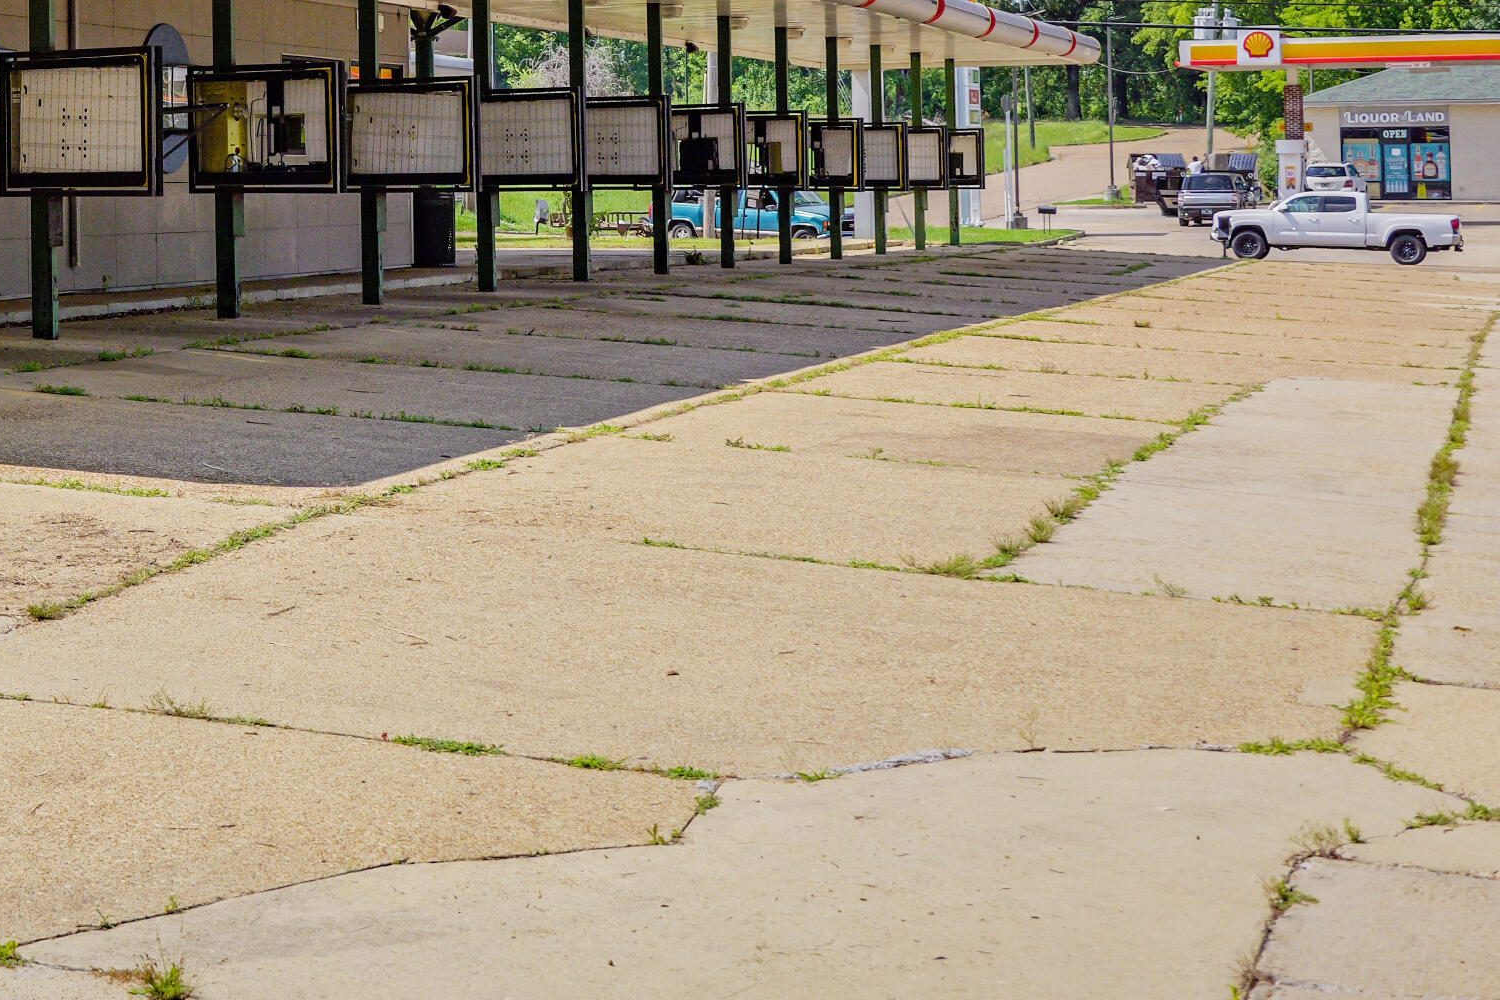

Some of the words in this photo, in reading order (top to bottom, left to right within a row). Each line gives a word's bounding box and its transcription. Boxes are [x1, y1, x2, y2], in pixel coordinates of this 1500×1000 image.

[1343, 111, 1400, 124] LIQUOR
[1404, 110, 1445, 122] LAND
[1383, 129, 1407, 139] OPEN
